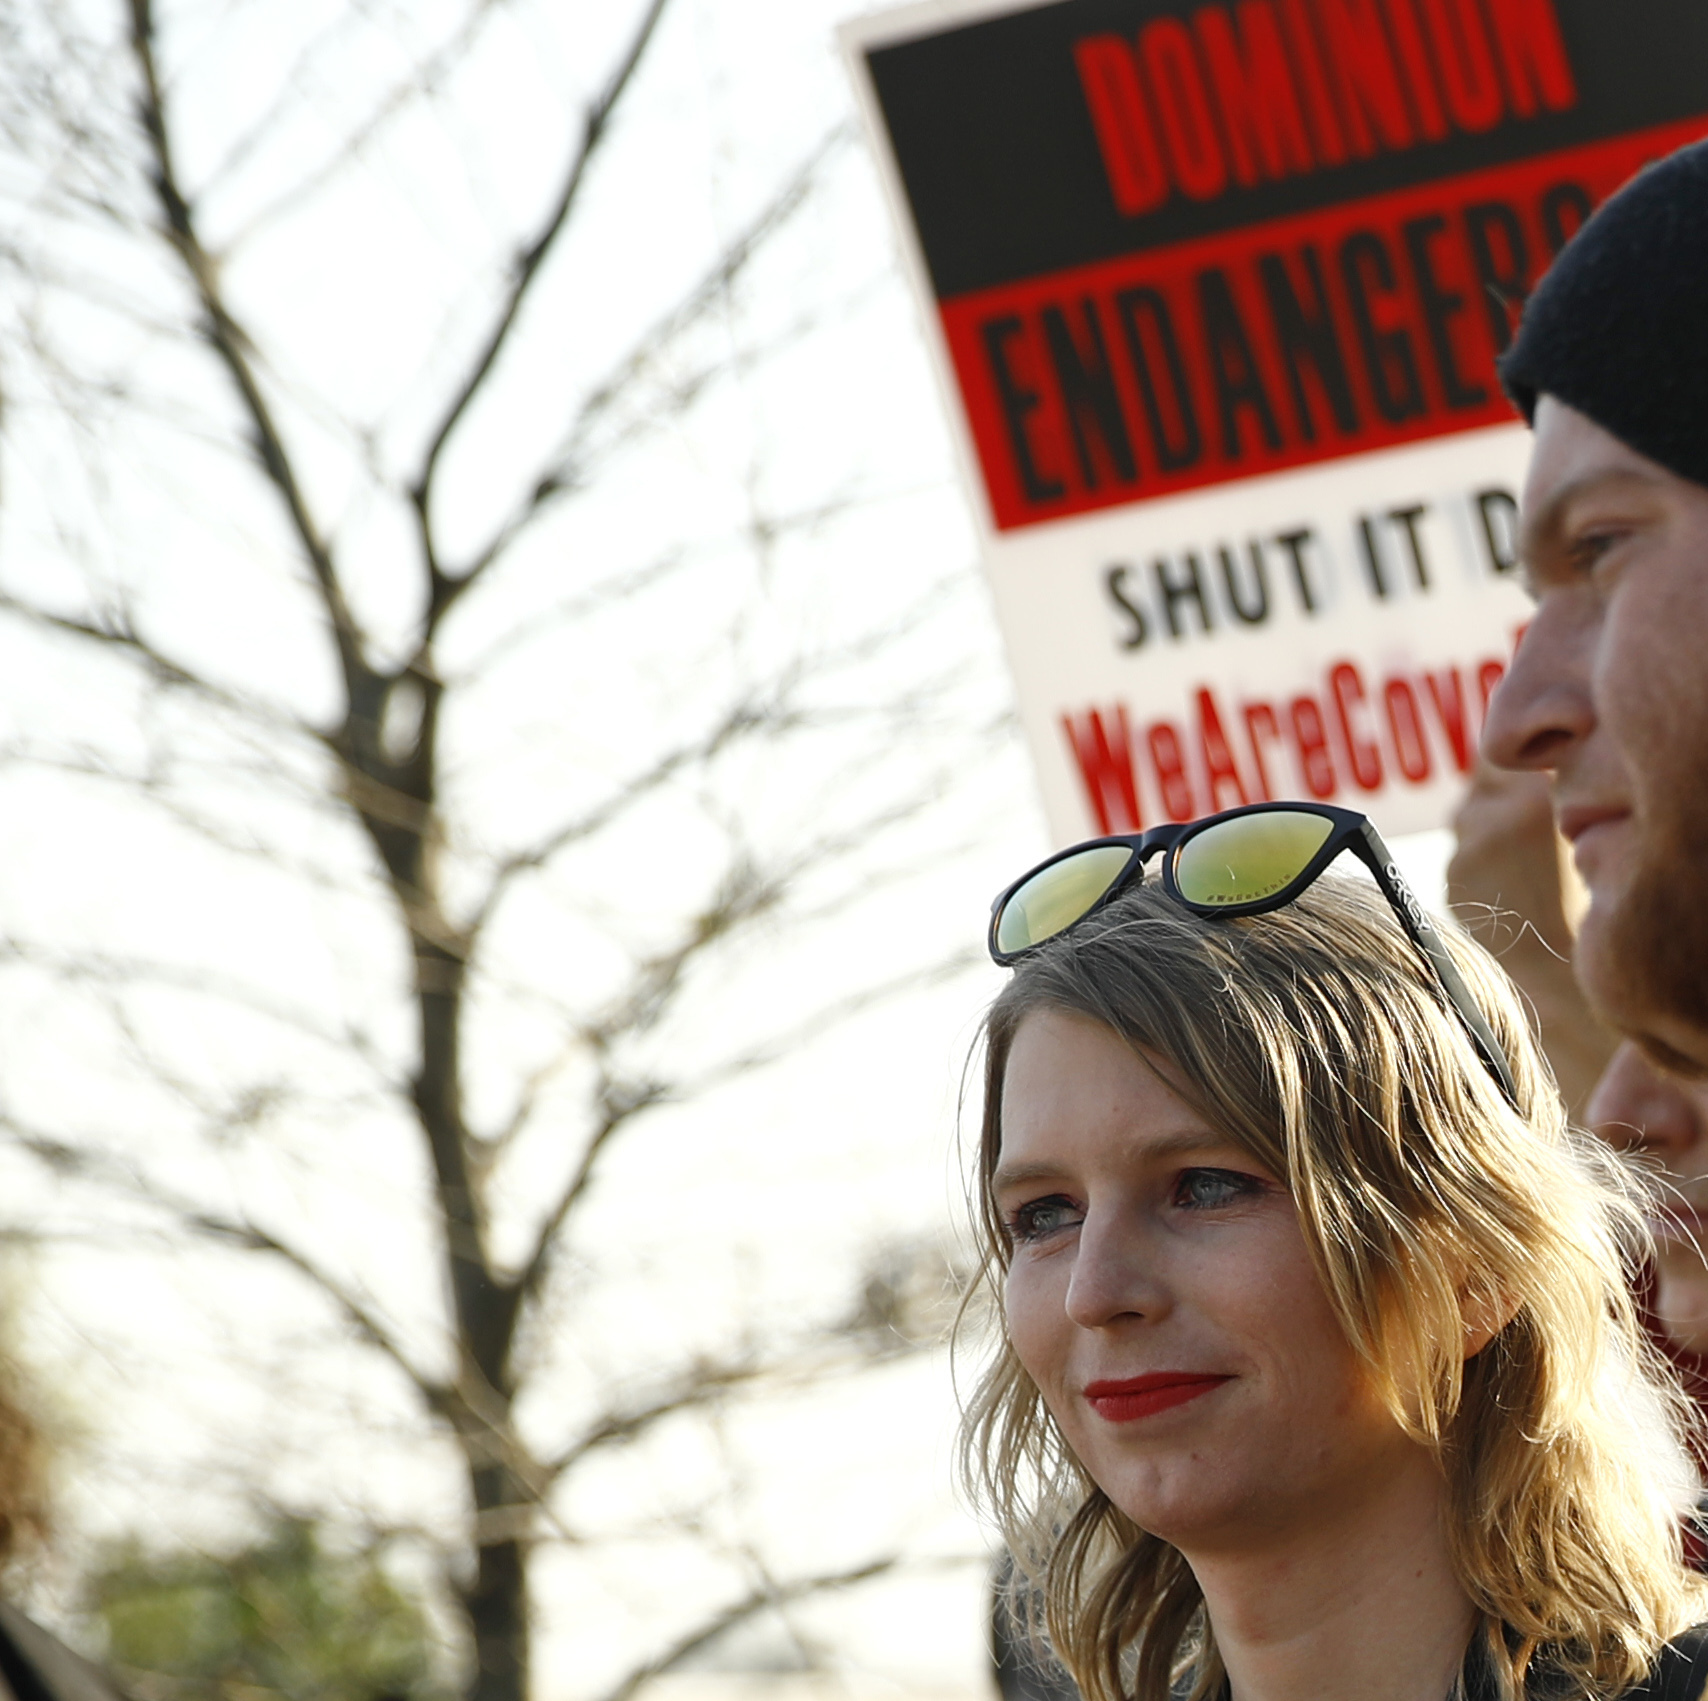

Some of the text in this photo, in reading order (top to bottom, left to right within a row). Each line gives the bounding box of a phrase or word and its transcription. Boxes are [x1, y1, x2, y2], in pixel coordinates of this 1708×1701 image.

[1074, 0, 1577, 217] DOMINION
[1104, 528, 1316, 654] SHUT
[1358, 503, 1430, 598] IT
